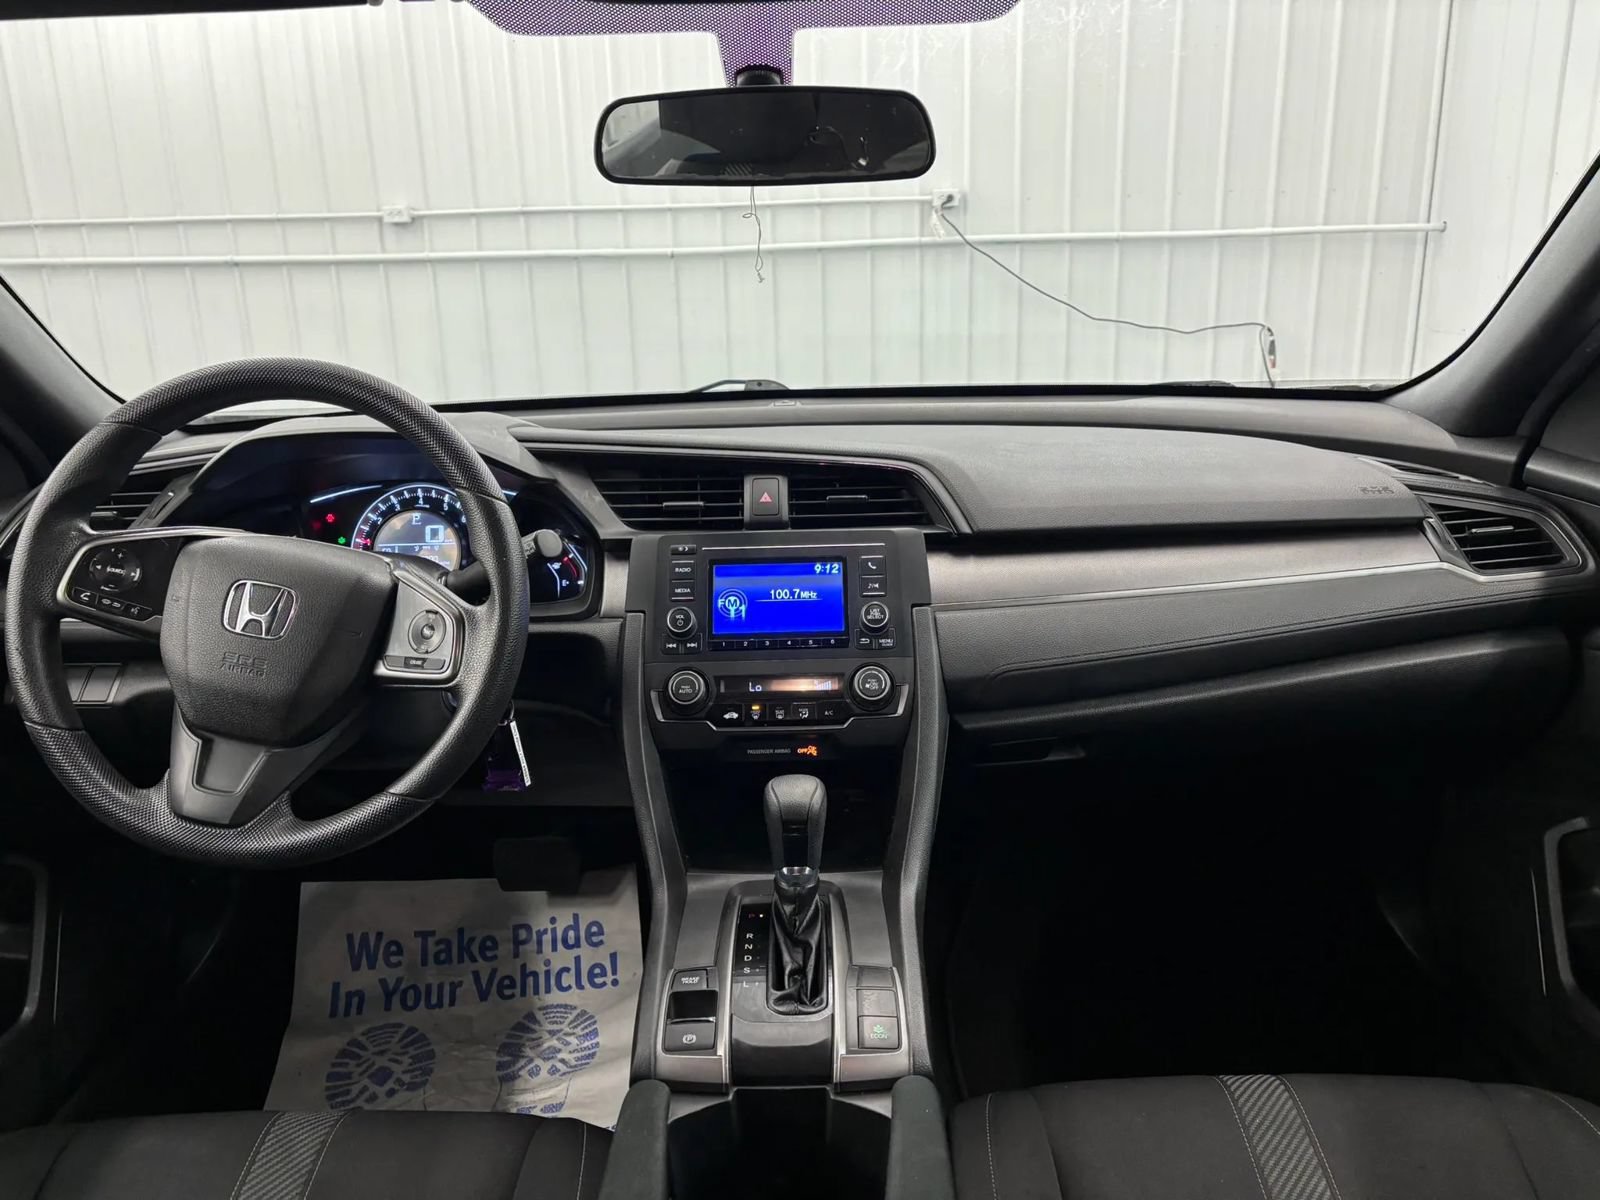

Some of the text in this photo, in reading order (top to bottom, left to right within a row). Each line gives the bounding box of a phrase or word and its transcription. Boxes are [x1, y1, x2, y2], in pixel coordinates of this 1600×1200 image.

[814, 563, 839, 574] 9:12
[748, 681, 762, 692] Lo
[345, 912, 605, 972] We Take Pride
[328, 951, 620, 1018] In Your Vehicle!
